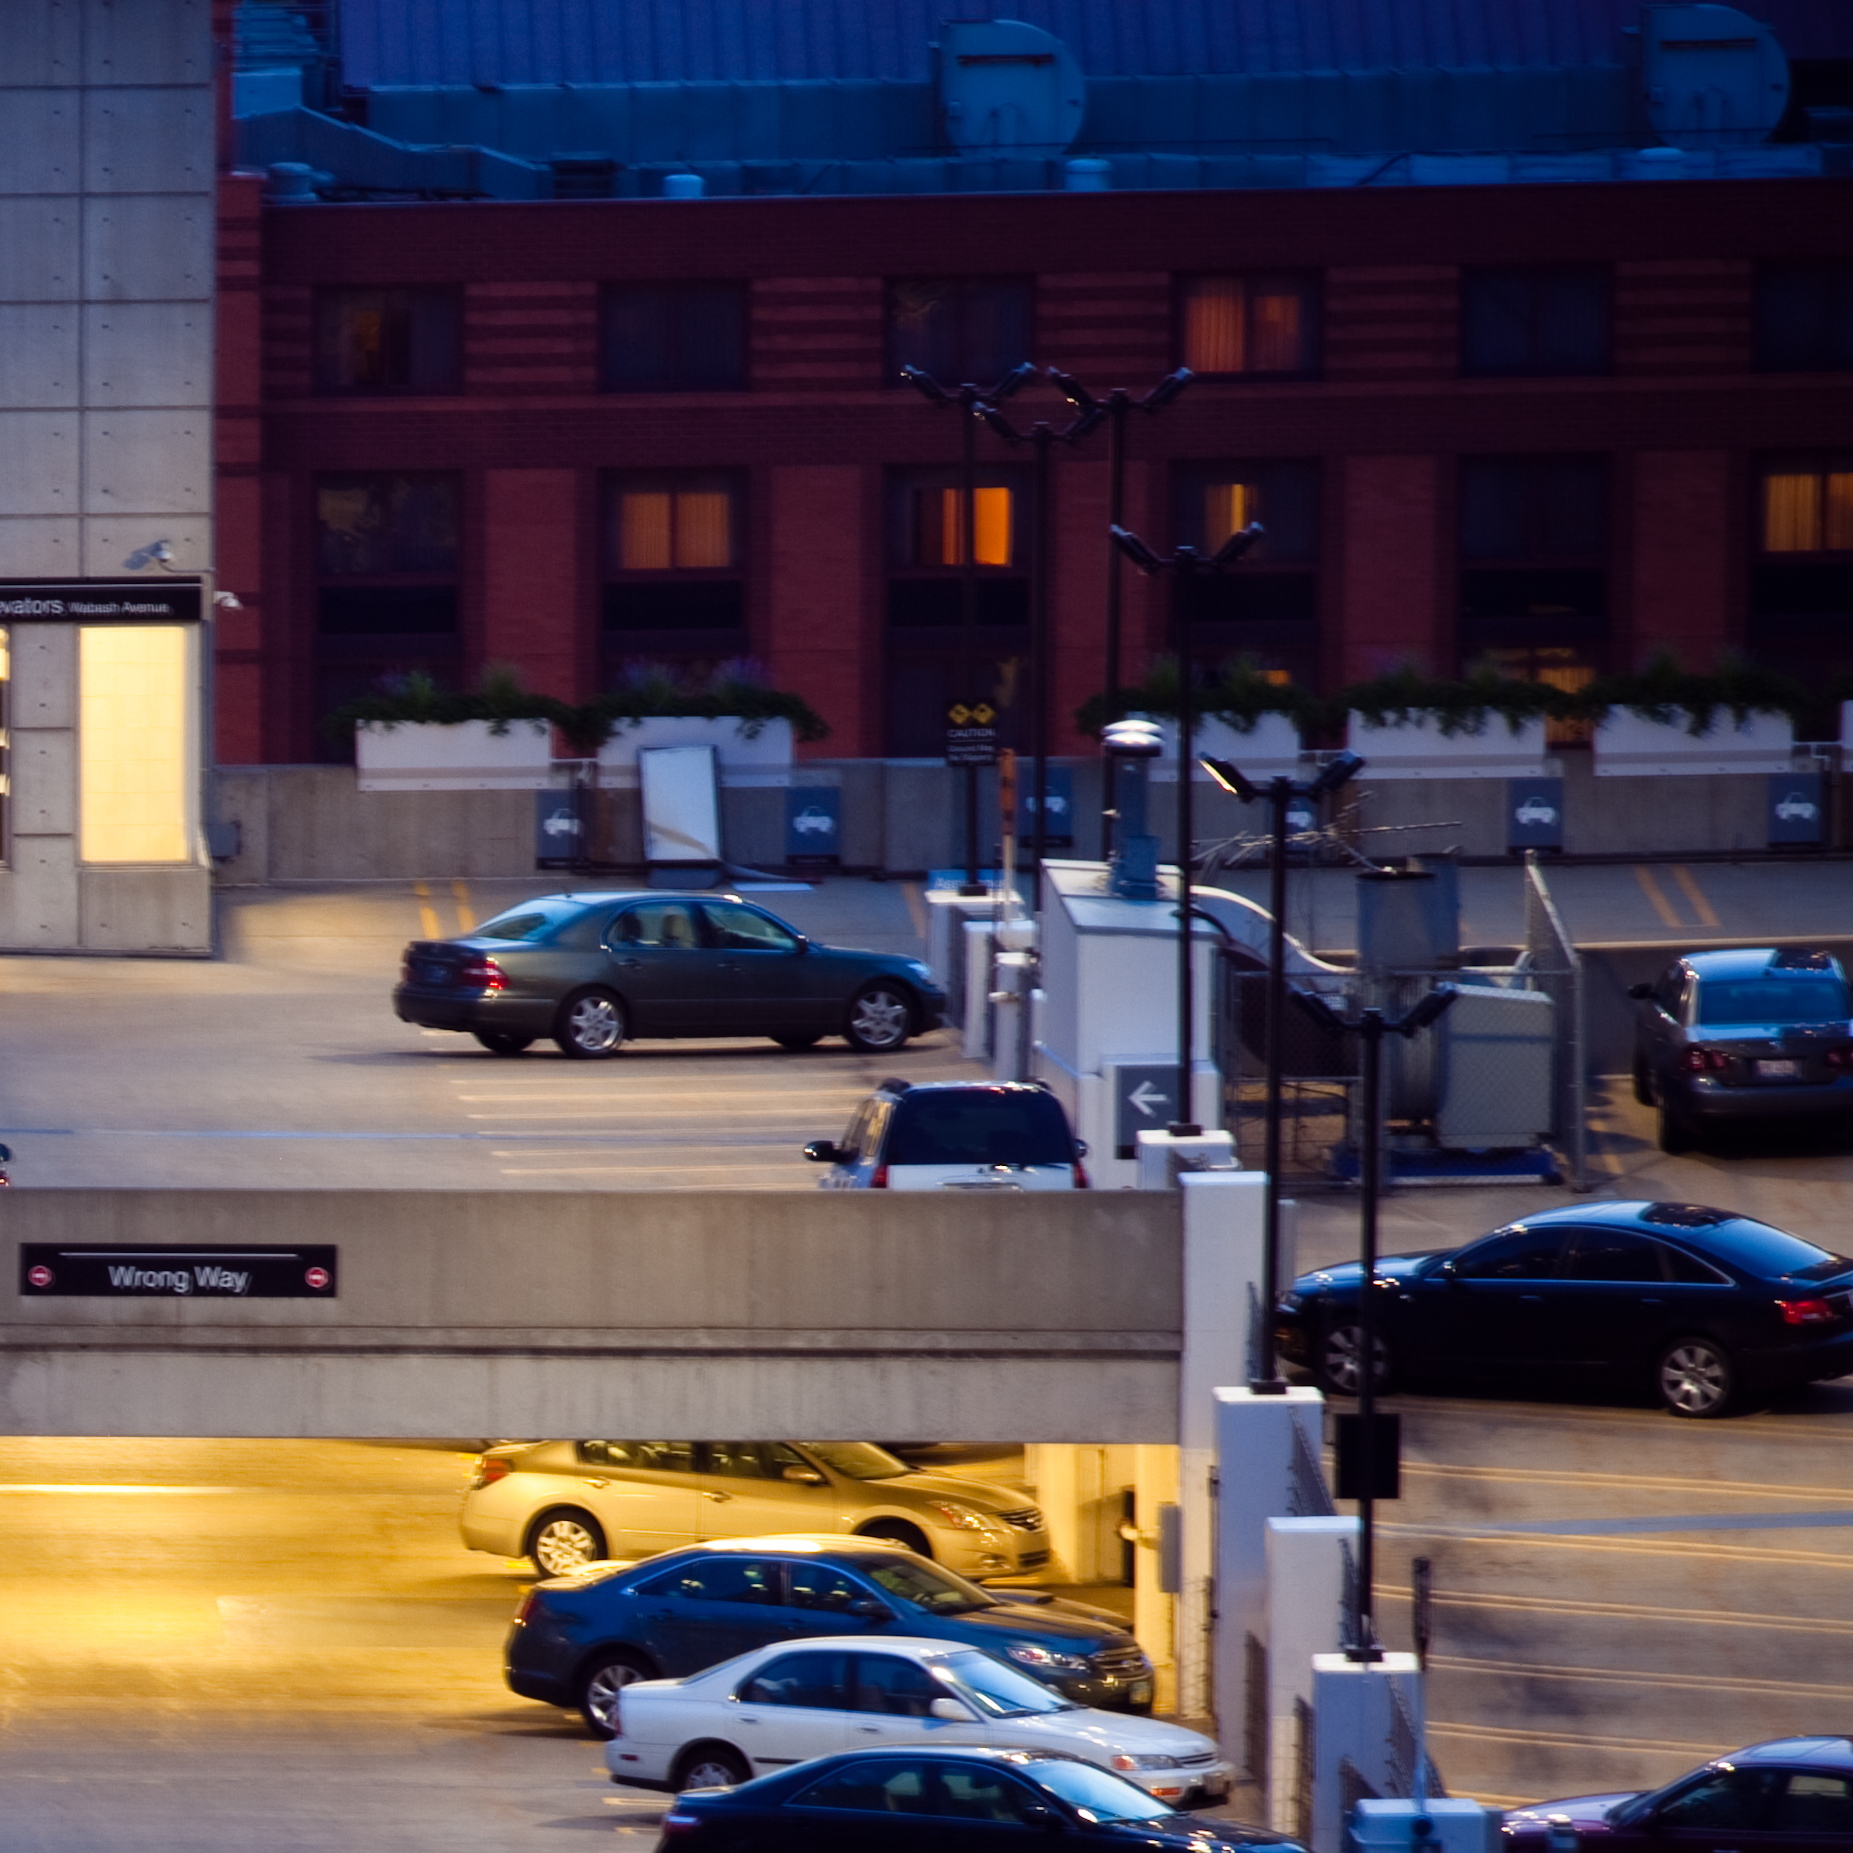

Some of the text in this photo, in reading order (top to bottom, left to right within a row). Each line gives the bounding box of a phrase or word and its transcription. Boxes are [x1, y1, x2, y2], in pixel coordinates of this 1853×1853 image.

[68, 600, 121, 616] Wabash
[123, 600, 171, 616] Avenue
[948, 728, 996, 739] CAUTION
[108, 1266, 251, 1293] Wrong Way
